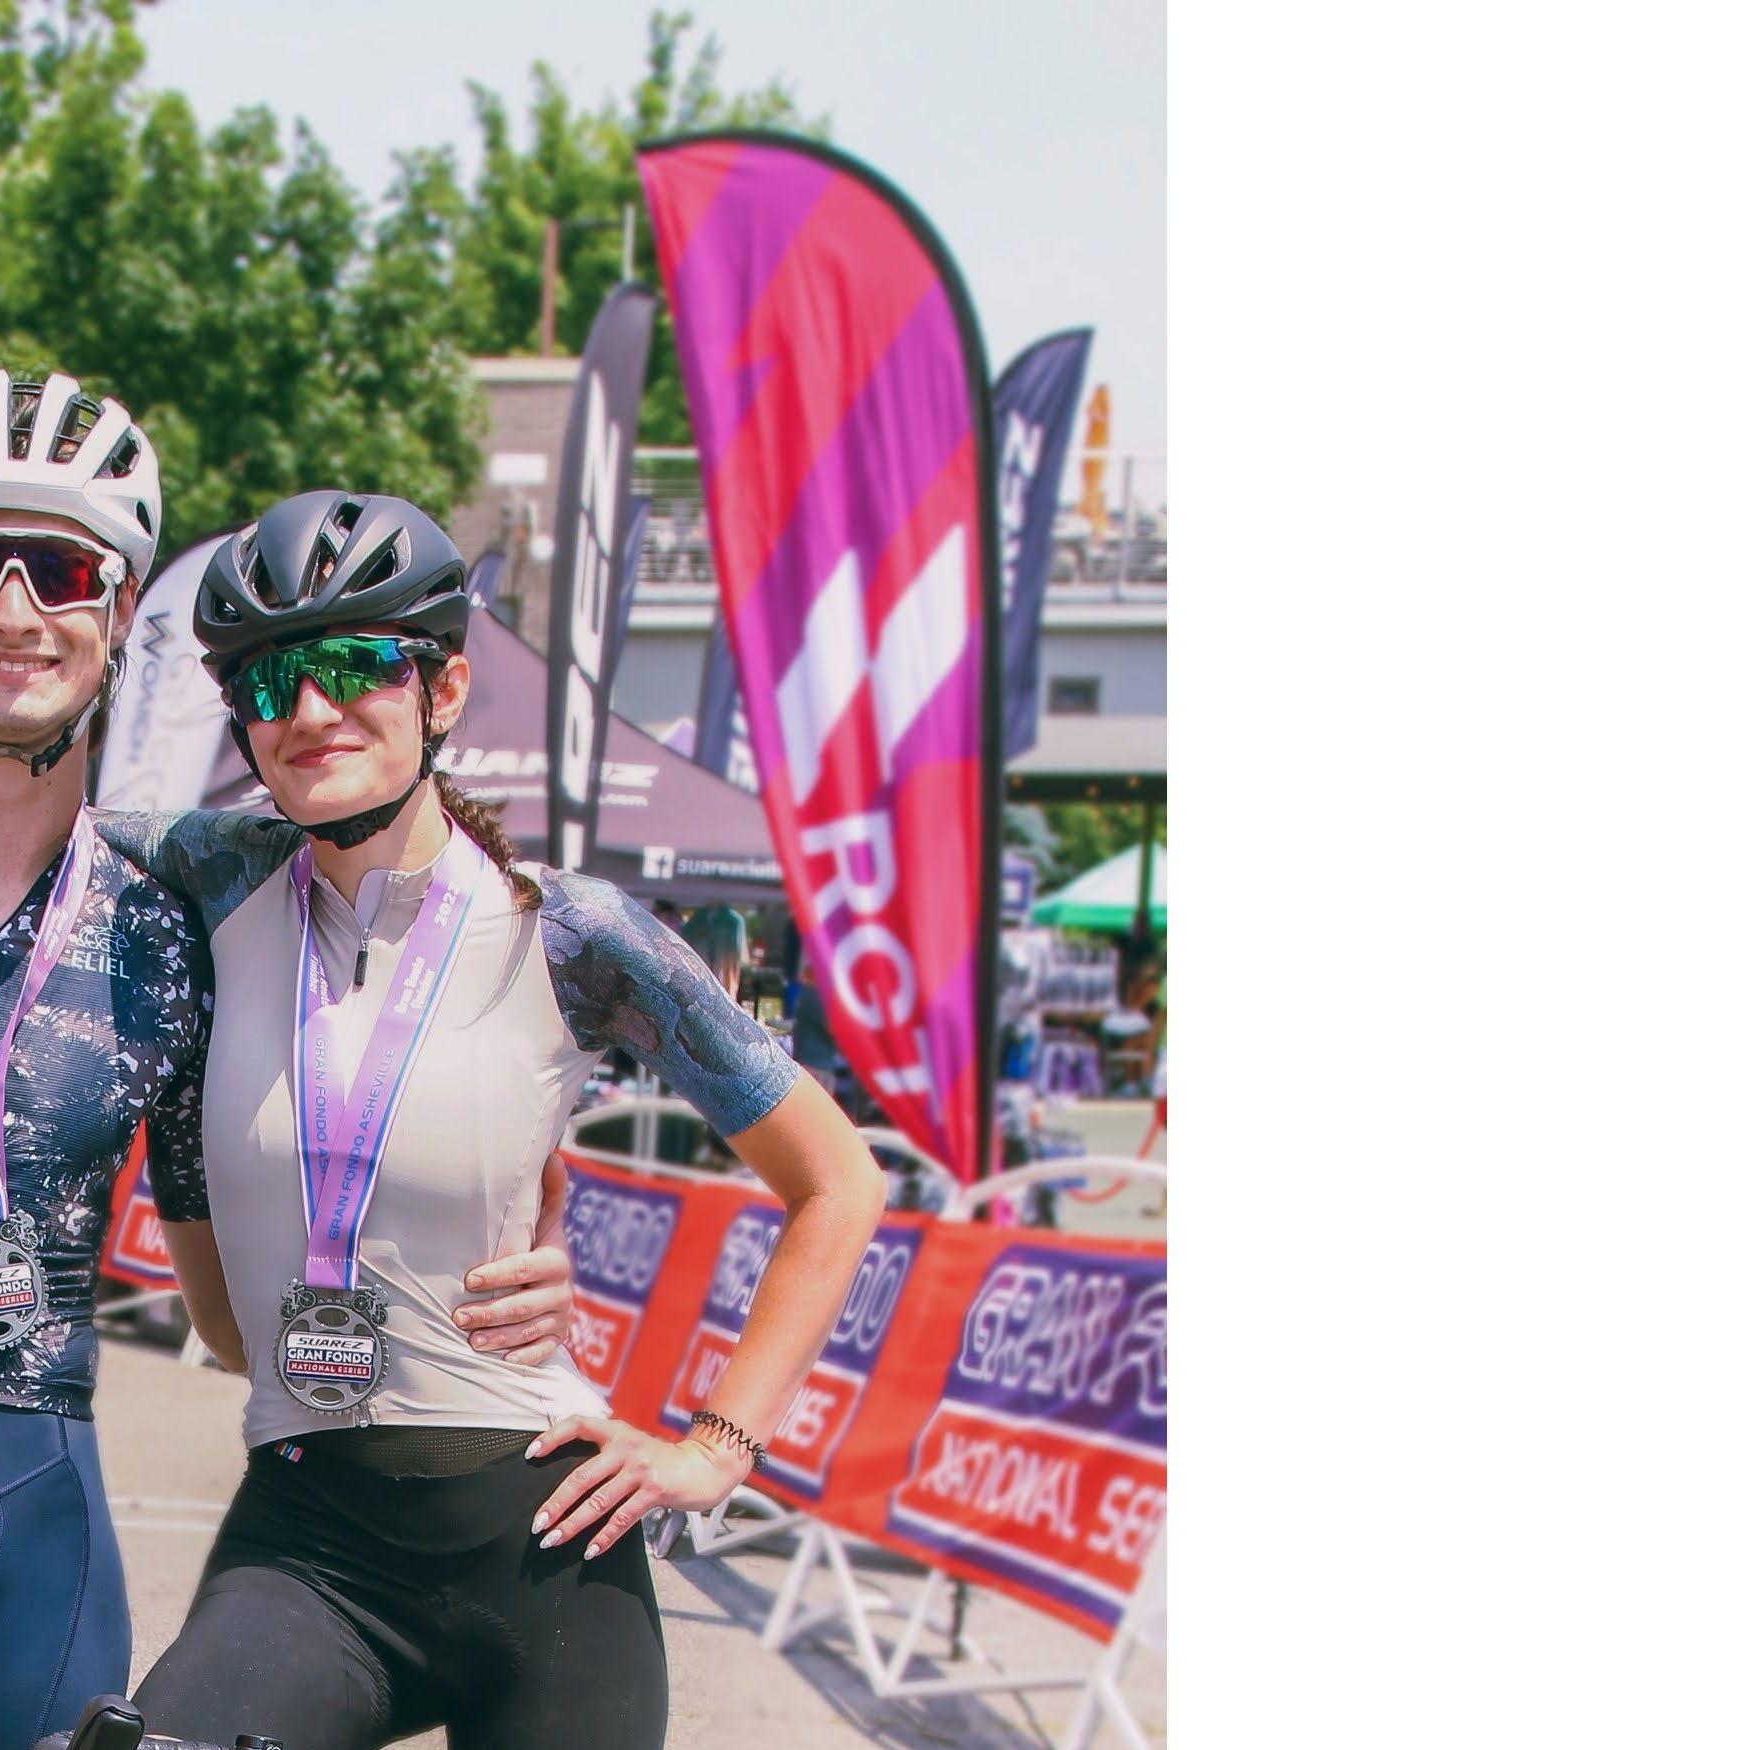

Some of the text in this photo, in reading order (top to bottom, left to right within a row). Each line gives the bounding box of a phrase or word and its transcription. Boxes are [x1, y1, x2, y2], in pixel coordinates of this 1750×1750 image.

[70, 950, 130, 979] ELIEL
[309, 954, 319, 996] Finisher
[798, 812, 941, 1124] RGT
[315, 1037, 327, 1082] GRAN
[315, 1084, 327, 1143] FONDO
[328, 1048, 396, 1241] GRAN FONDO ASHEVILLE
[0, 1292, 32, 1305] SERIES
[287, 1348, 373, 1365] GRAN FONDO
[296, 1337, 365, 1350] SUAREZ
[291, 1362, 368, 1375] NATIONAL SERIES
[918, 1430, 1079, 1543] NATIONAL
